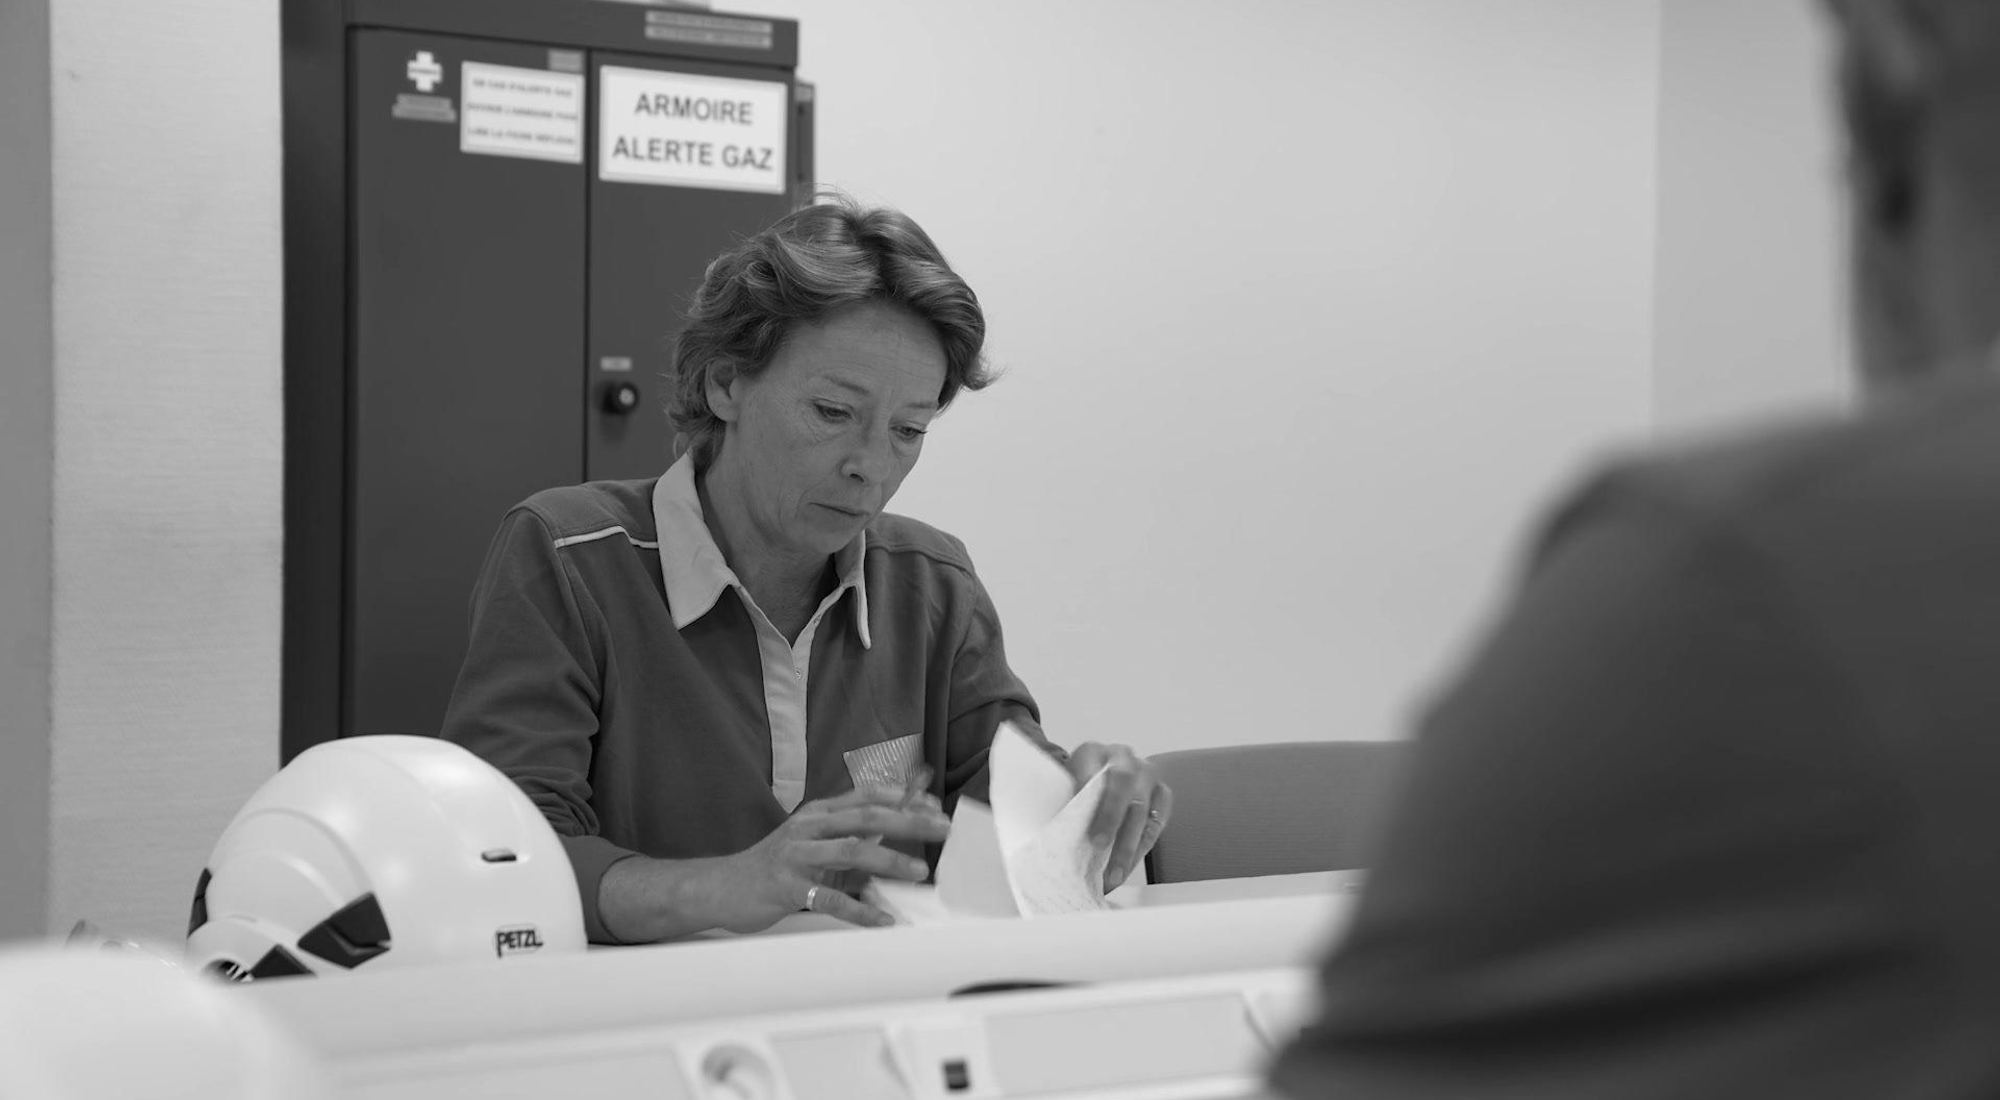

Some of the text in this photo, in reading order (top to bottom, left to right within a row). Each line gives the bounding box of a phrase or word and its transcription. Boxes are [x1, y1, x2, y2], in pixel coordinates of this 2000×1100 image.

[634, 92, 754, 125] ARMOIRE
[612, 135, 774, 171] ALERTE GAZ
[496, 930, 543, 959] PETZL
